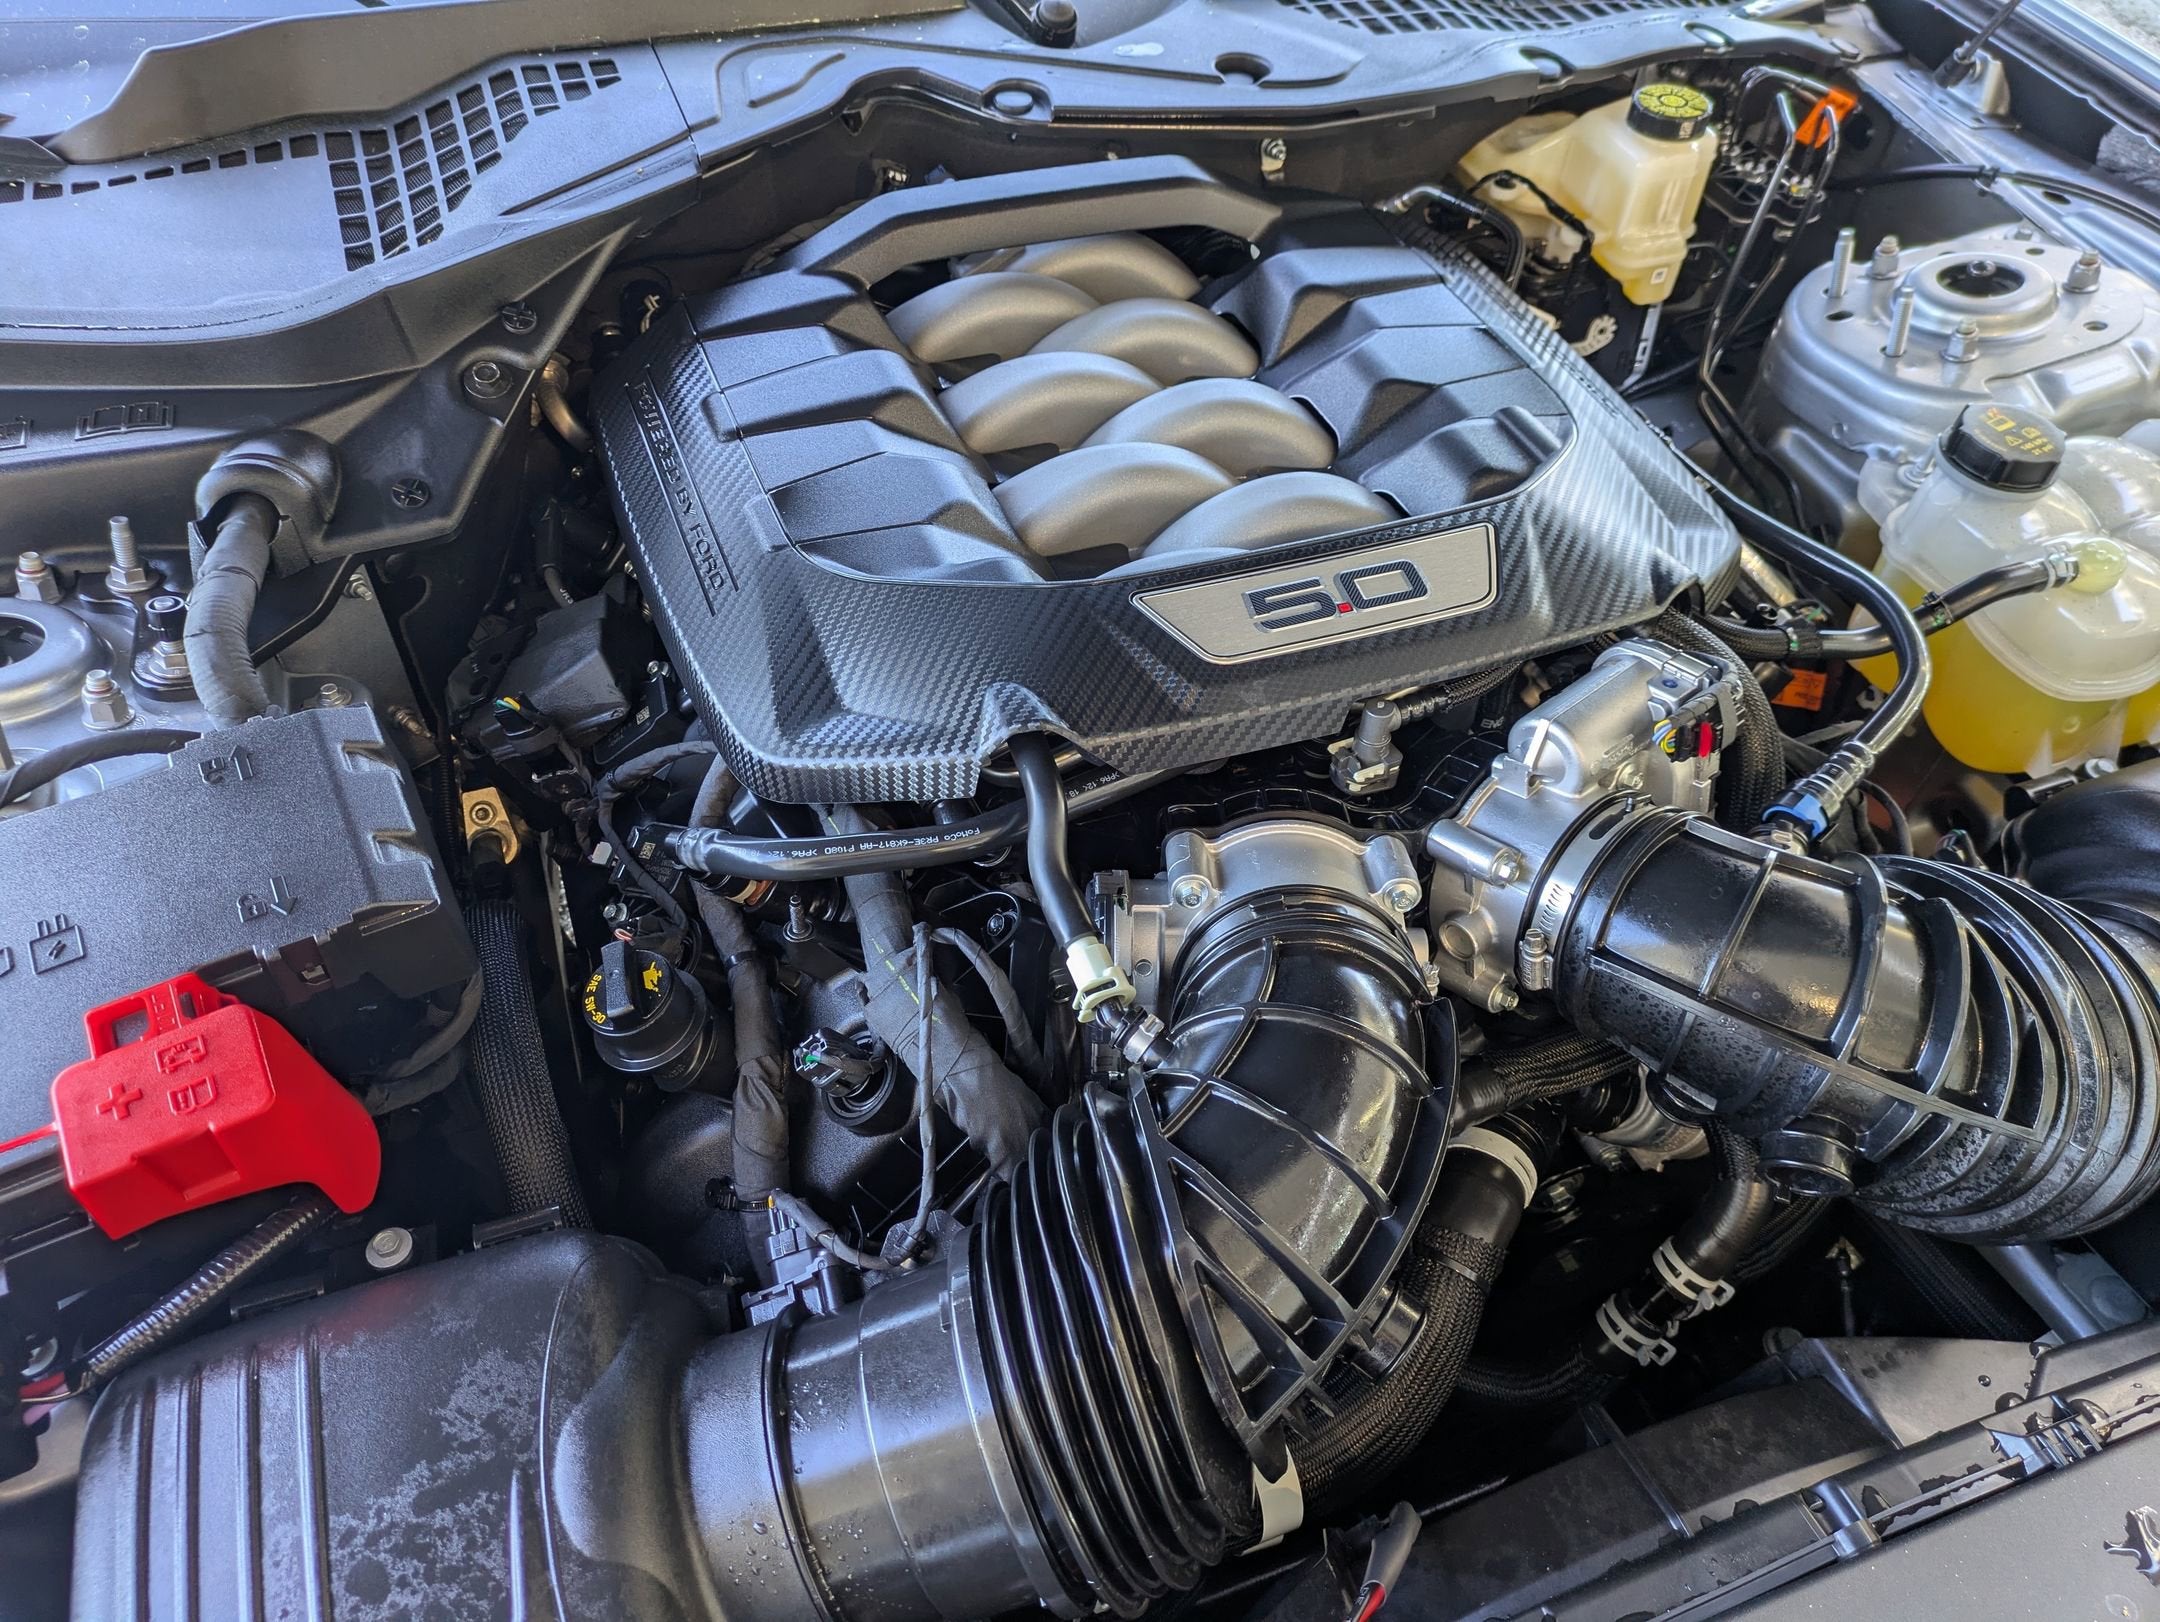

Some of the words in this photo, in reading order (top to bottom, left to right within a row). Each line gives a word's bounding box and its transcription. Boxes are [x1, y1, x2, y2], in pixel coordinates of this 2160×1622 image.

[634, 381, 682, 484] POWERED
[675, 487, 697, 516] BY
[689, 522, 725, 591] FORD
[1241, 559, 1432, 633] 5.0
[859, 835, 939, 851] PR3E-6K817-AA
[943, 827, 981, 841] FoMoCo
[586, 974, 602, 993] SAE
[584, 996, 607, 1024] 5W-30
